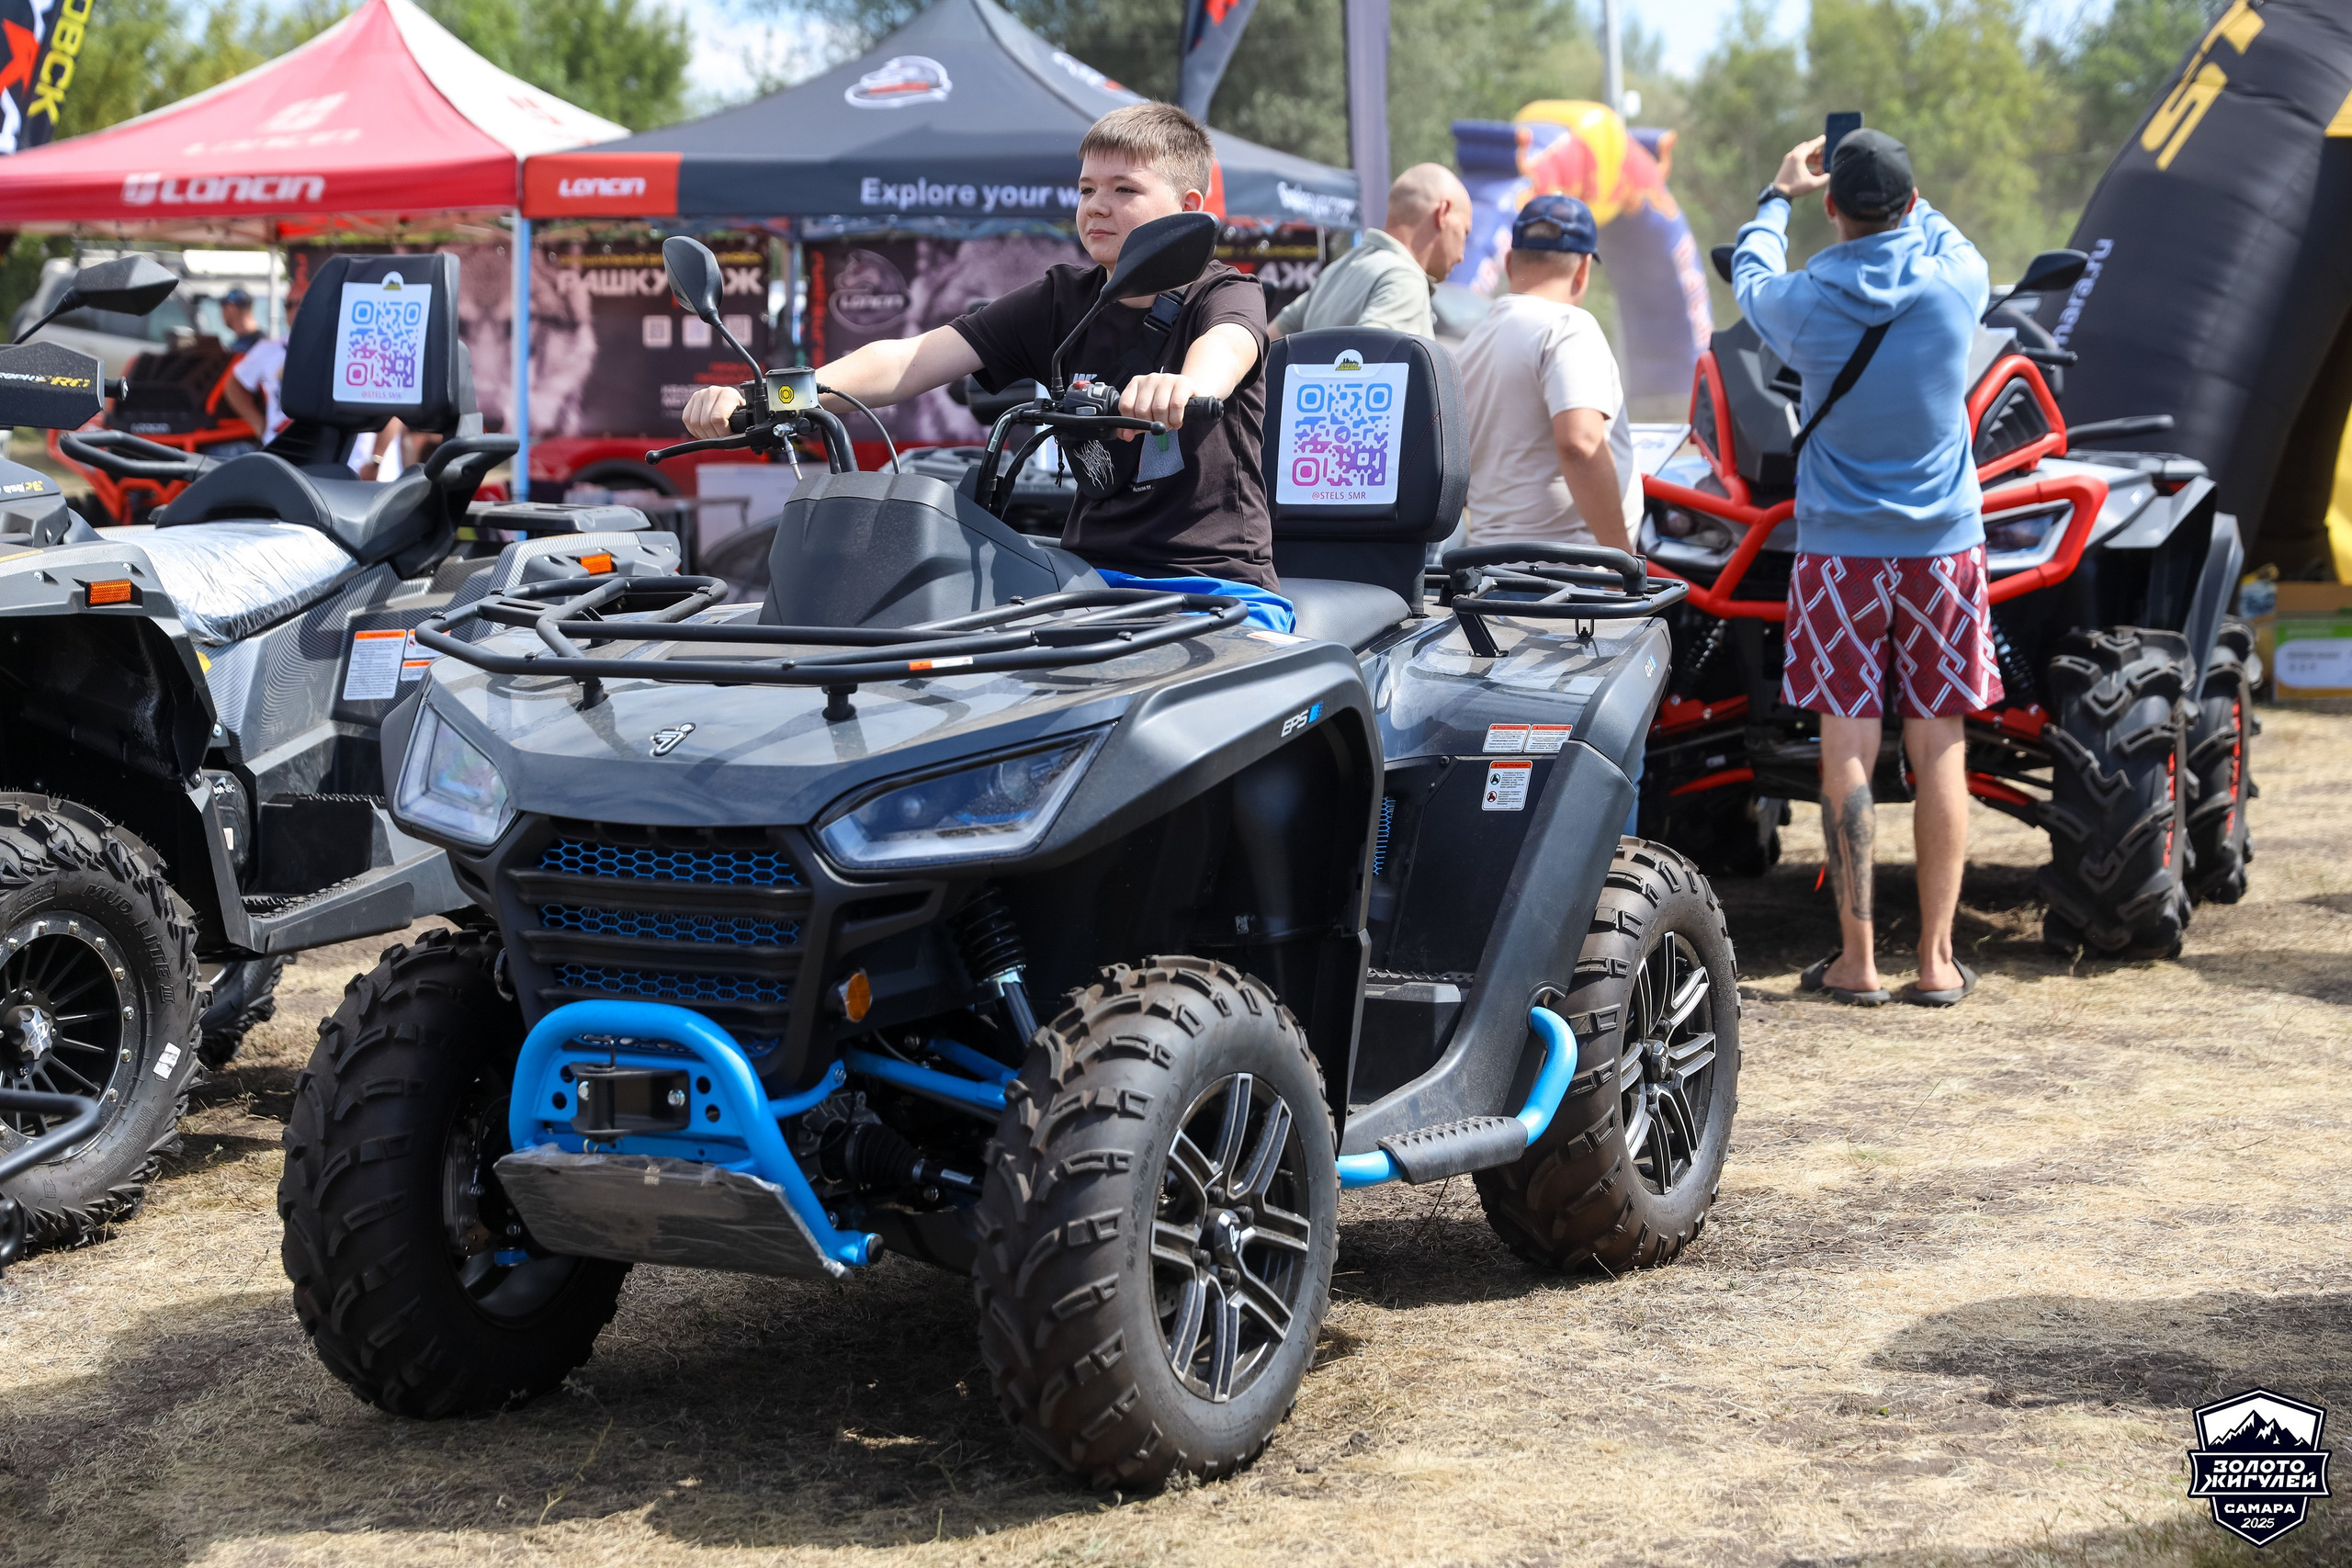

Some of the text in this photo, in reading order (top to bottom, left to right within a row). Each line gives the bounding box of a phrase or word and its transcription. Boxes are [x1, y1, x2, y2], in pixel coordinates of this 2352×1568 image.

[159, 175, 326, 204] LONCIN
[559, 177, 647, 197] LONCIN
[860, 176, 1082, 213] Explore your w
[1312, 491, 1366, 502] @STELS_SMR
[1281, 709, 1309, 738] EPS
[83, 883, 134, 915] MUD
[134, 919, 172, 978] LITE
